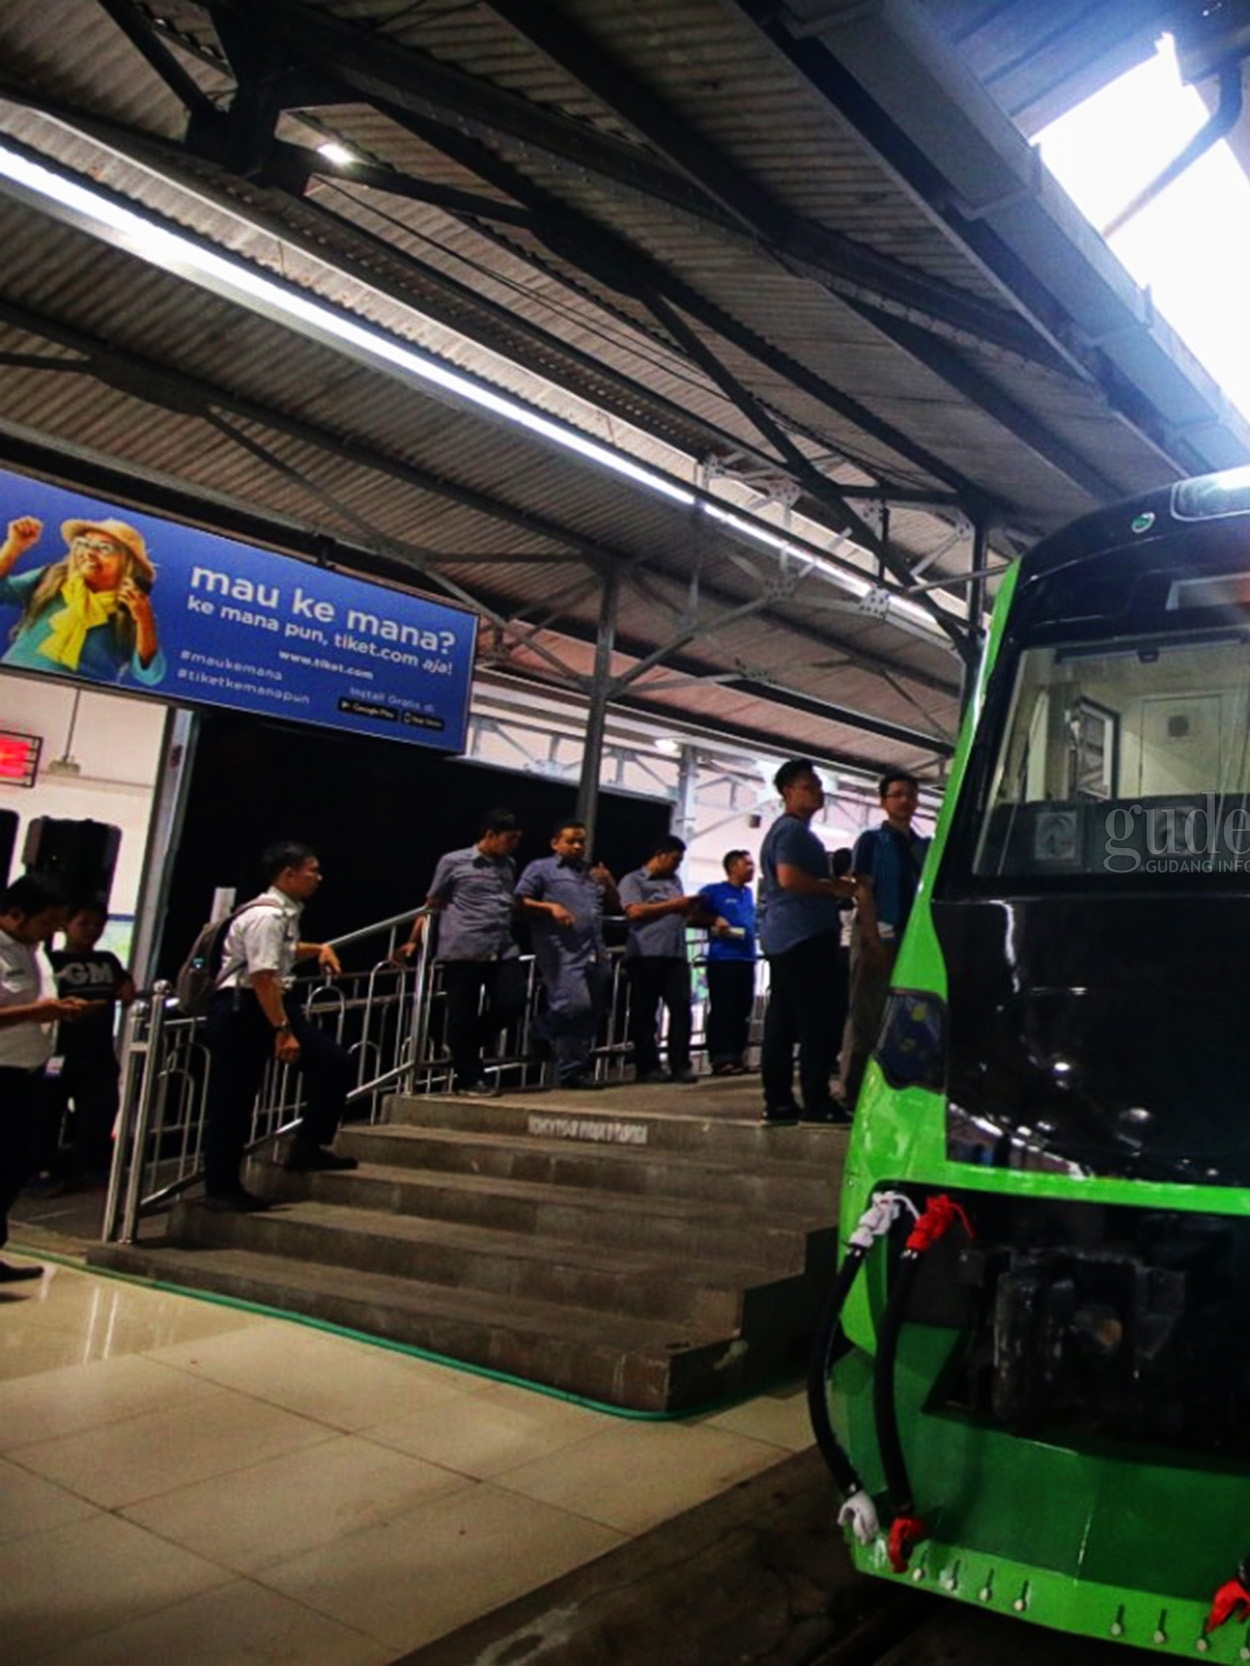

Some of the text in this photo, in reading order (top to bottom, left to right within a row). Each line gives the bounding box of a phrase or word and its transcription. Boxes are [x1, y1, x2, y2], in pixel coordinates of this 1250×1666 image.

[190, 566, 456, 655] mau ke mana?
[187, 595, 453, 675] ke mana pun, tiket.com aja!
[180, 650, 282, 681] #maukemana
[279, 650, 374, 680] www.tiket.com
[178, 669, 310, 704] #tiketkemanapun
